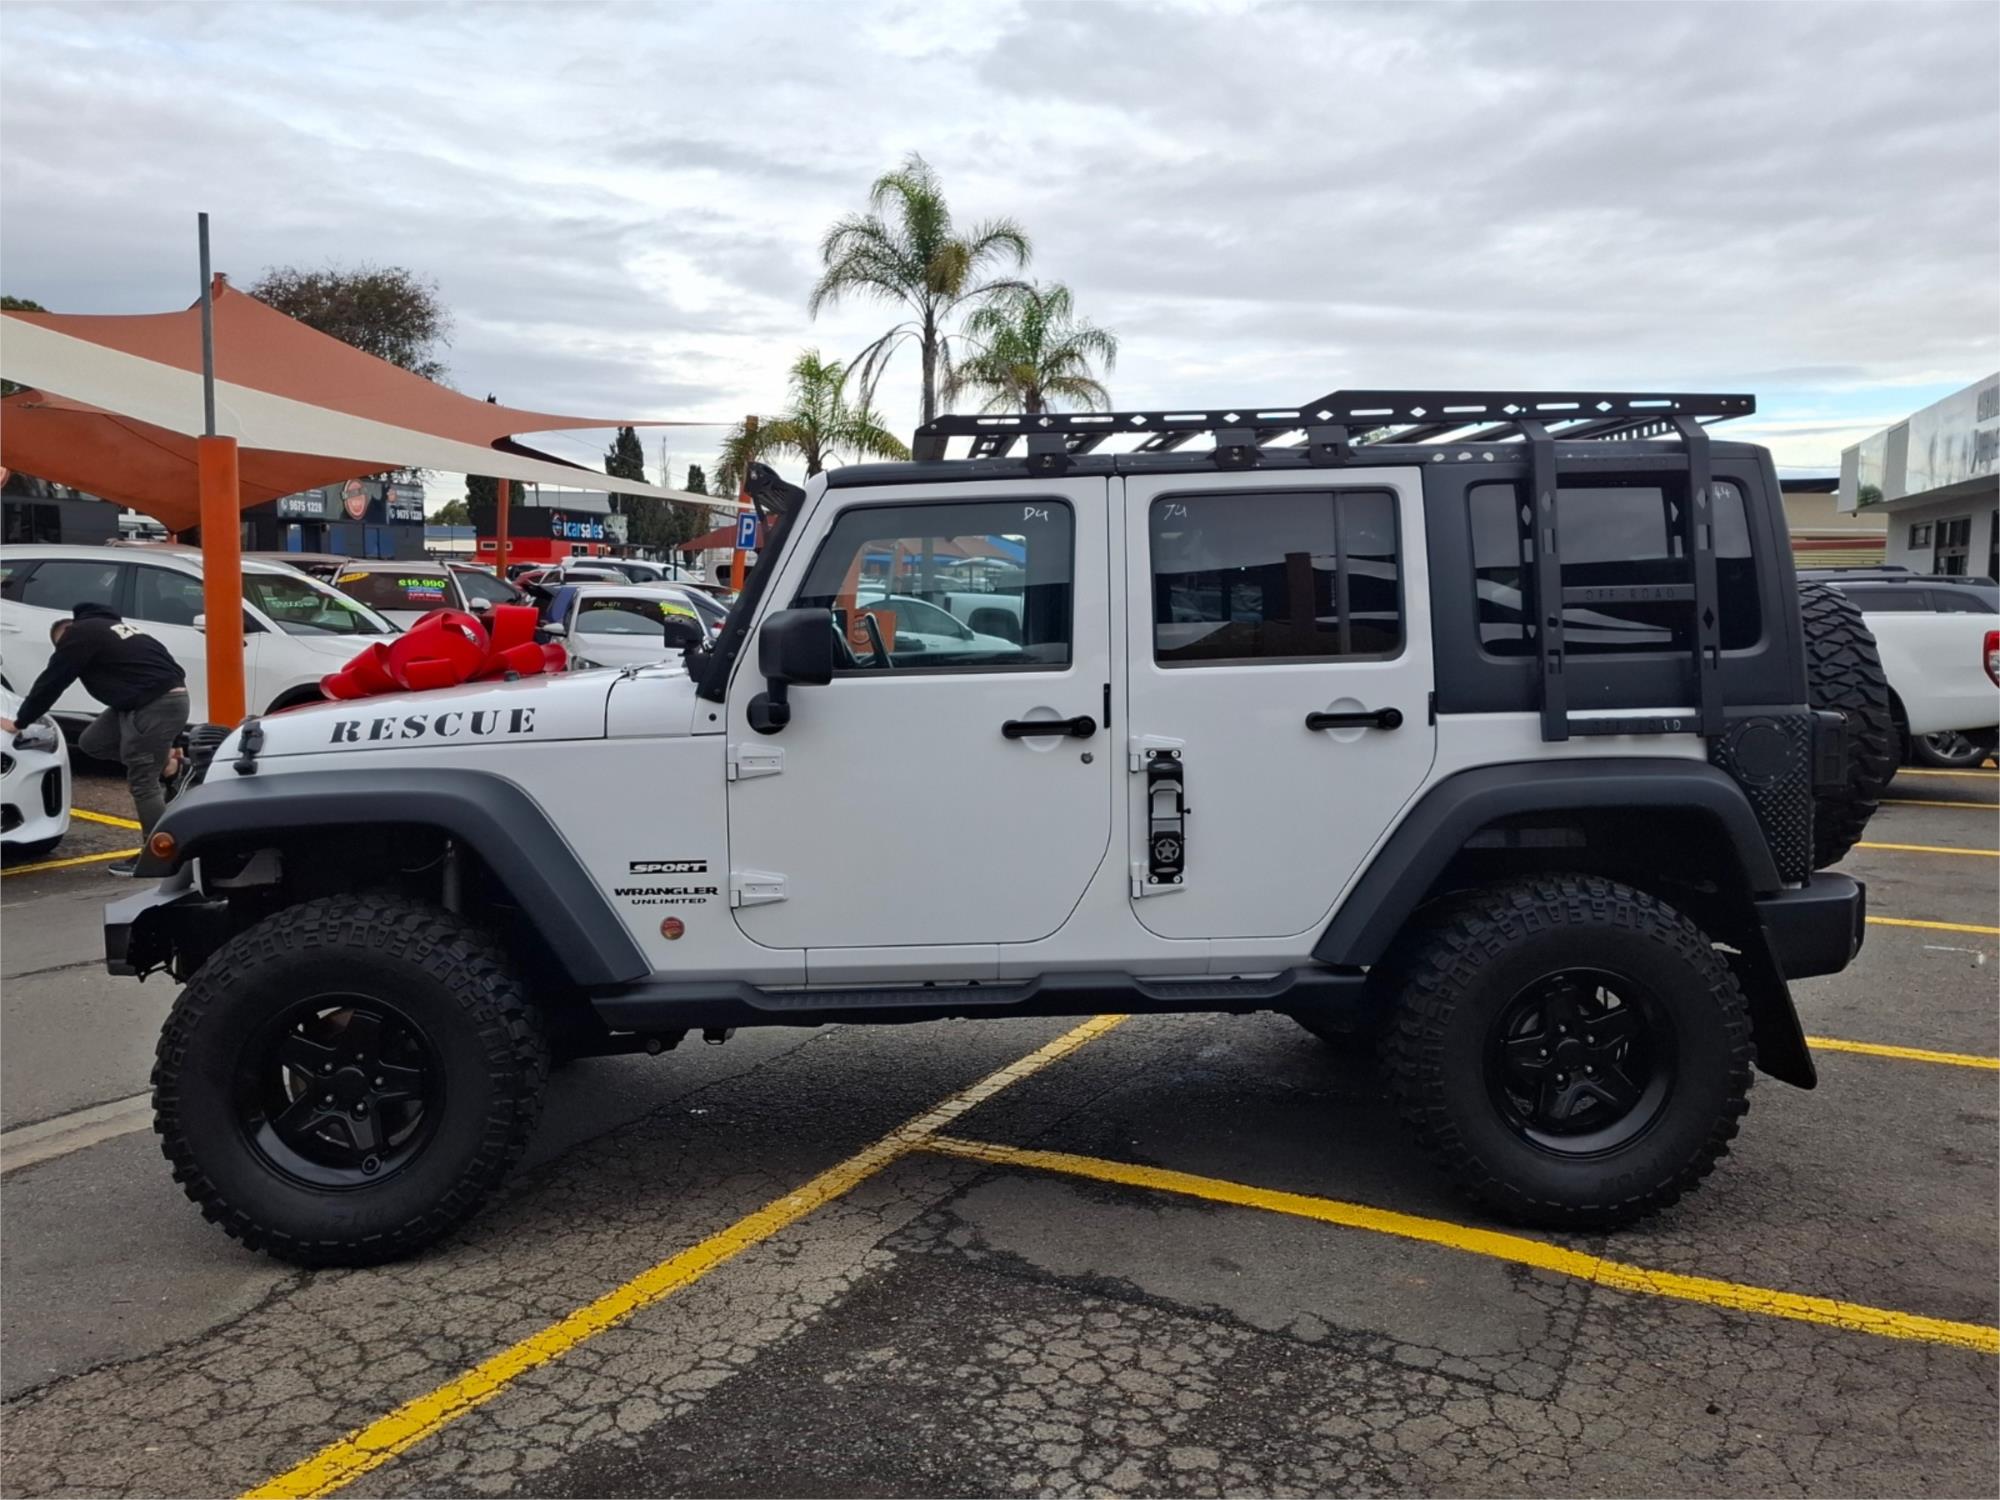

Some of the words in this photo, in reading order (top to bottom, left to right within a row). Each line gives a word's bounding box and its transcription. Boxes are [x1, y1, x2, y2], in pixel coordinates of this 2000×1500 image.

[741, 518, 754, 544] P
[329, 708, 536, 744] RESCUE
[632, 862, 706, 873] SPORT
[614, 886, 720, 896] WRANGLER
